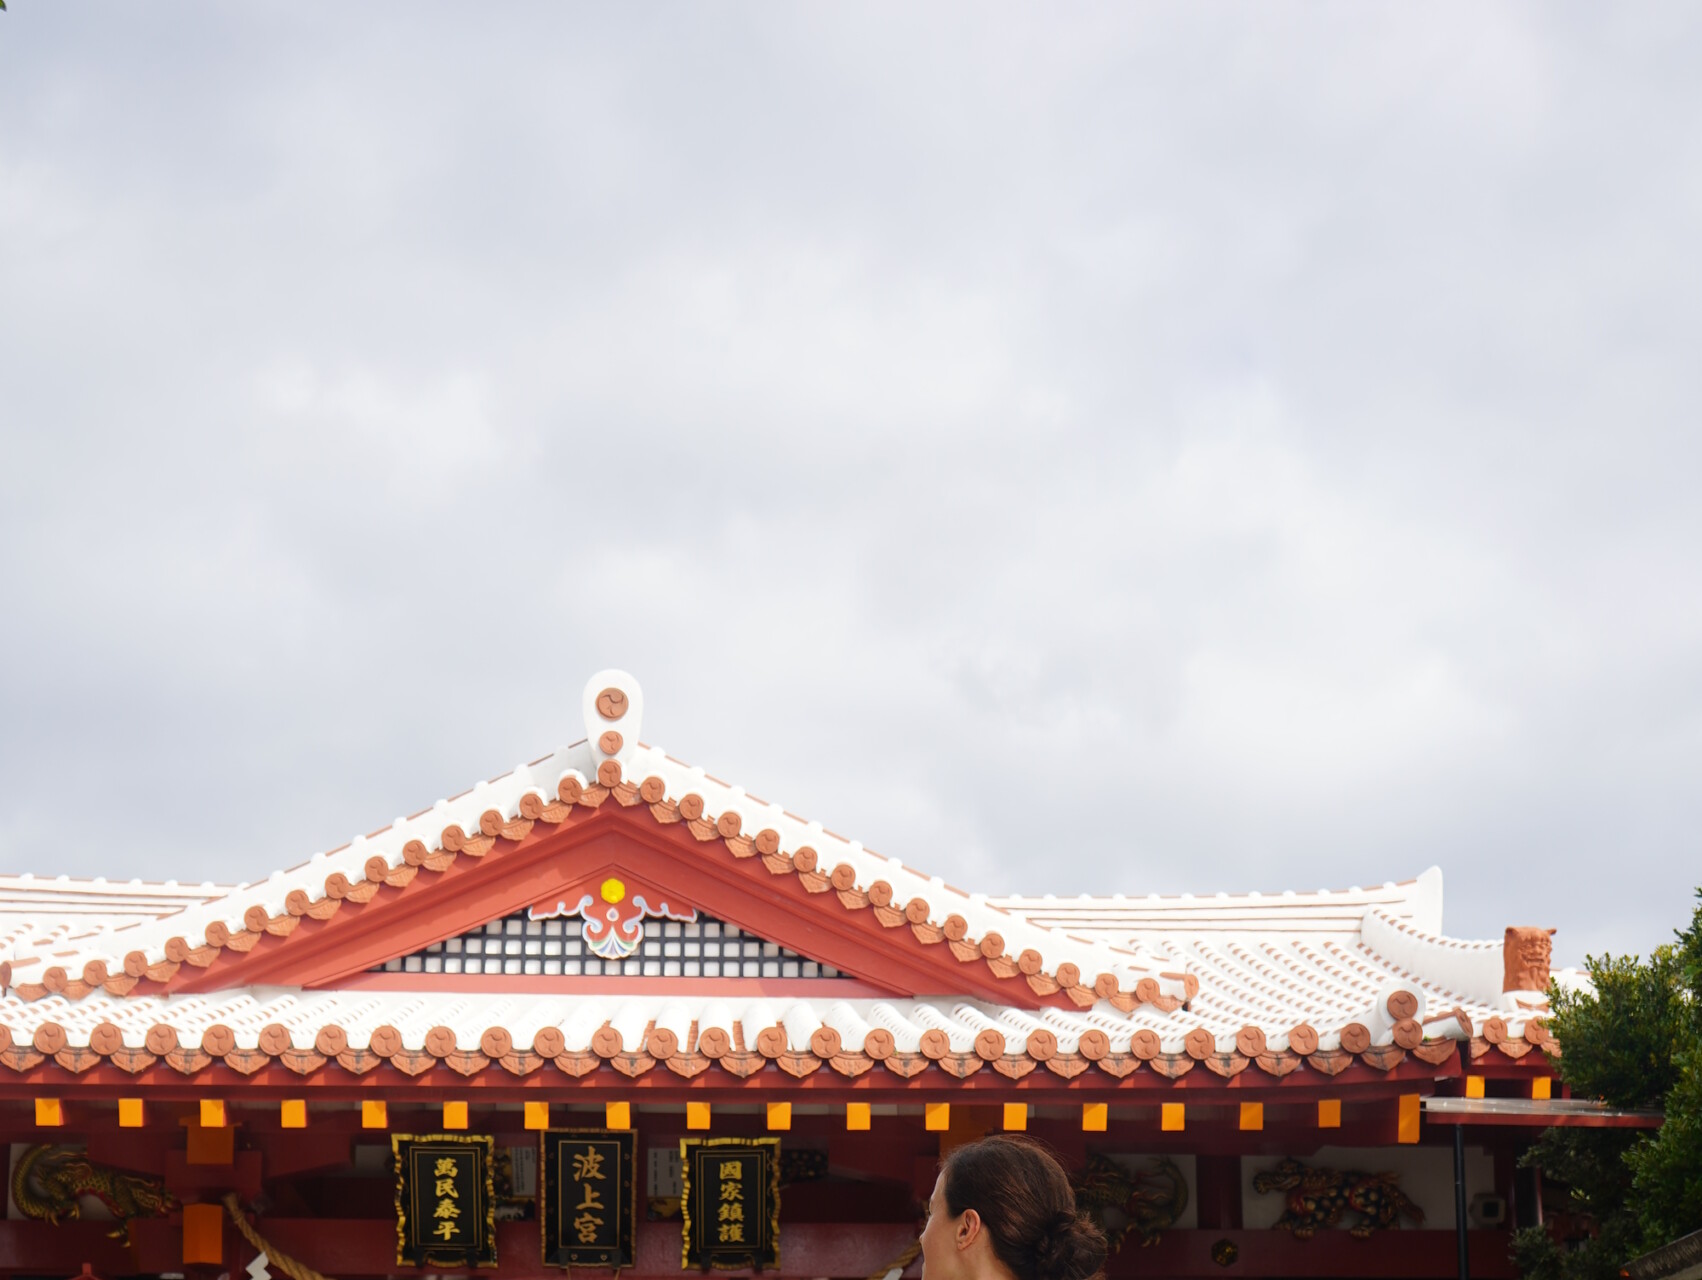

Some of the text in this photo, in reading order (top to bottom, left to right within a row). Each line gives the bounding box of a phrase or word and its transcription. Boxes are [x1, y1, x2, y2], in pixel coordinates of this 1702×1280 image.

[433, 1157, 461, 1241] 萬民泰平
[572, 1145, 608, 1244] 波上宮
[717, 1160, 745, 1242] 國家鎮護
